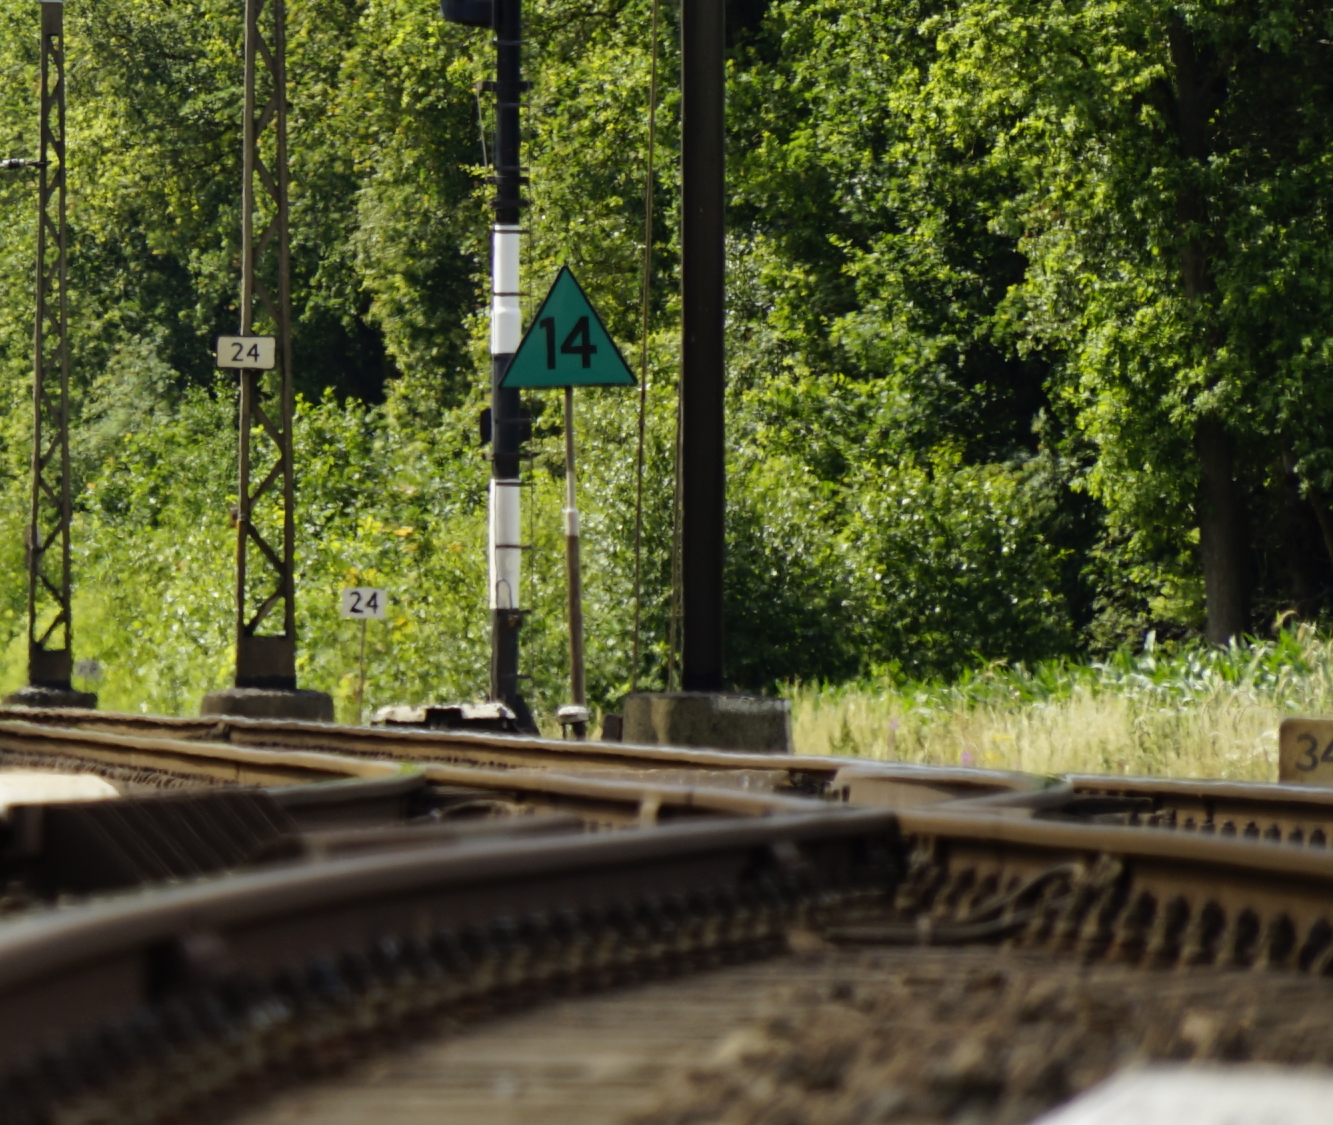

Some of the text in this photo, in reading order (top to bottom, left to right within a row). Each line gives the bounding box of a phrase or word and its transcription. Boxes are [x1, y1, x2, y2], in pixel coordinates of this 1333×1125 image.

[231, 342, 260, 363] 24
[539, 316, 598, 370] 14
[349, 590, 379, 614] 24
